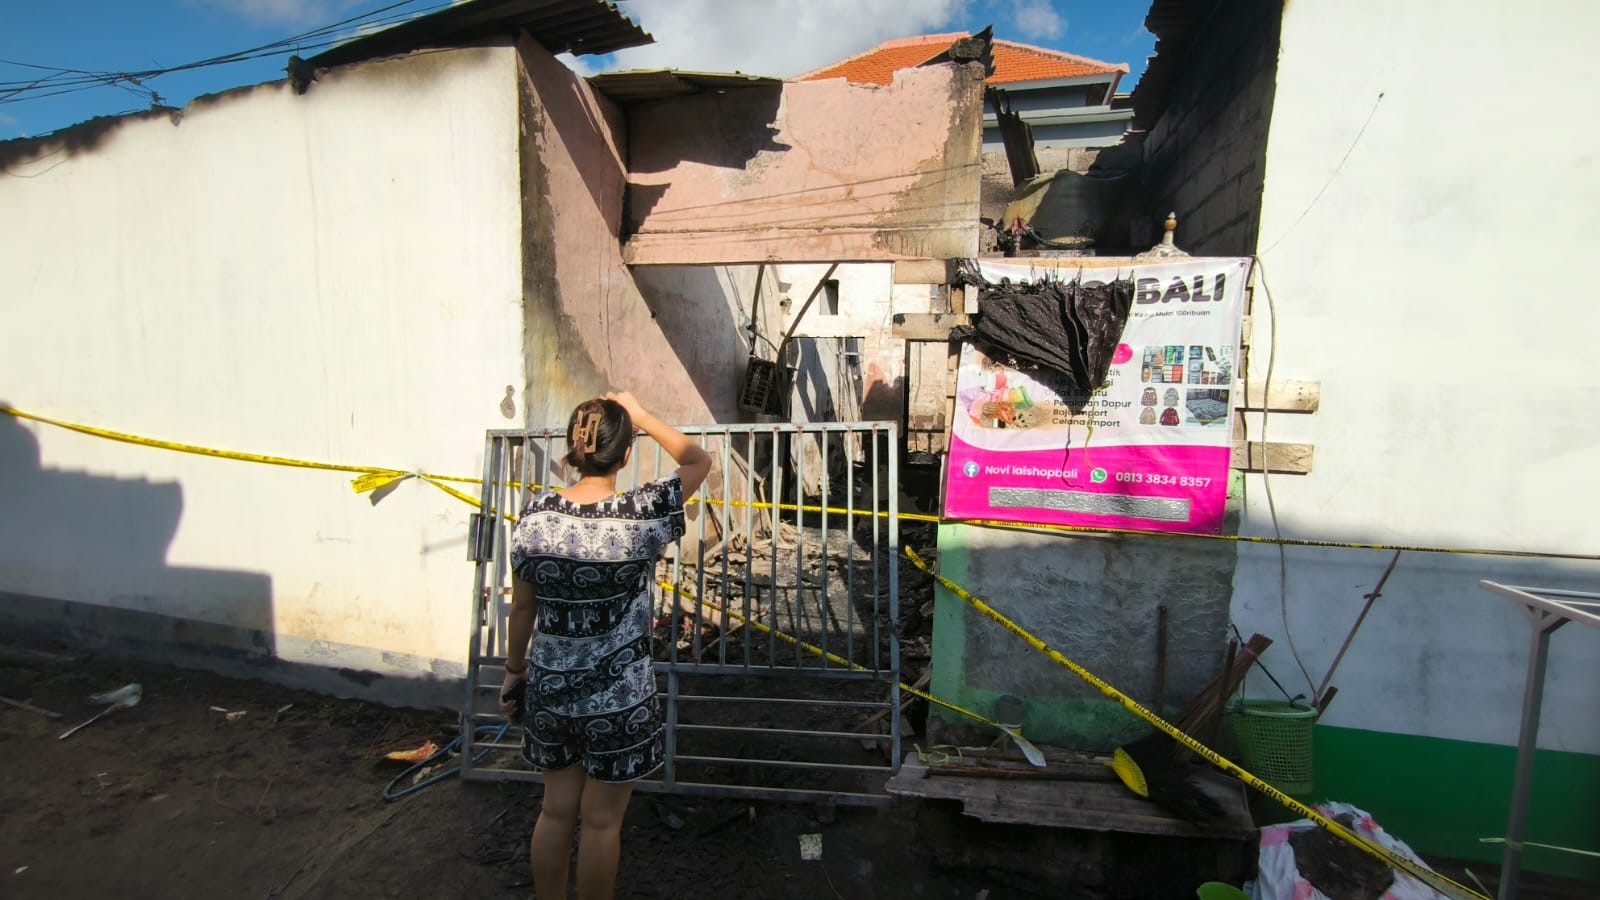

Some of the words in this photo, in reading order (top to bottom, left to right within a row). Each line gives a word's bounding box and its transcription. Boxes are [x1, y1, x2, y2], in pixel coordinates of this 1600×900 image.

[1053, 399, 1099, 407] Peralatan
[1101, 400, 1132, 409] Dapur
[1052, 418, 1086, 426] Celana
[985, 465, 1010, 475] Novi
[1012, 465, 1078, 480] laishopbali
[1115, 471, 1143, 483] 0813
[1145, 473, 1177, 485] 3834
[1179, 476, 1212, 488] 8357
[1250, 778, 1286, 803] GARIS
[1288, 802, 1329, 830] POLISI
